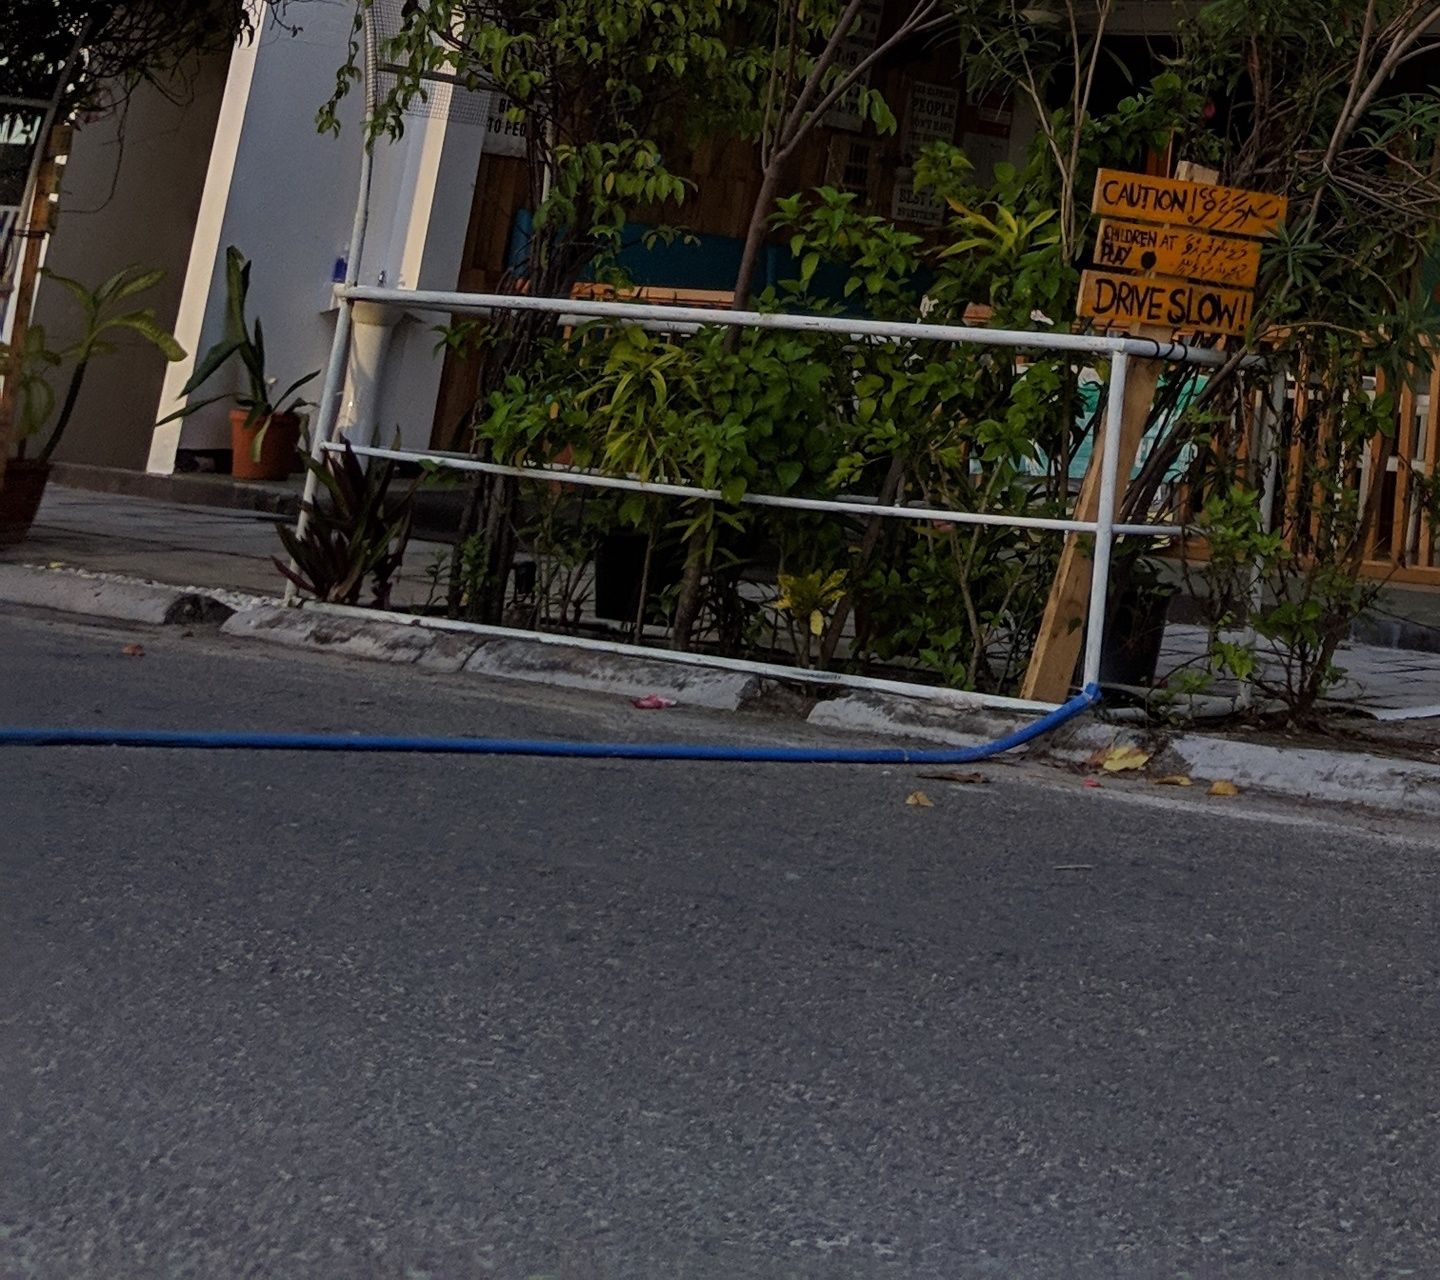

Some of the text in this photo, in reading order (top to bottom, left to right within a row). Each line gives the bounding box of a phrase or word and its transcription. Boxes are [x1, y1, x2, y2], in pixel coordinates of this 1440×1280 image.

[487, 116, 501, 133] TO
[1104, 225, 1178, 251] CHILDREN AT
[1101, 239, 1132, 265] PLAY
[1092, 278, 1247, 331] DRIVE SLOW!
